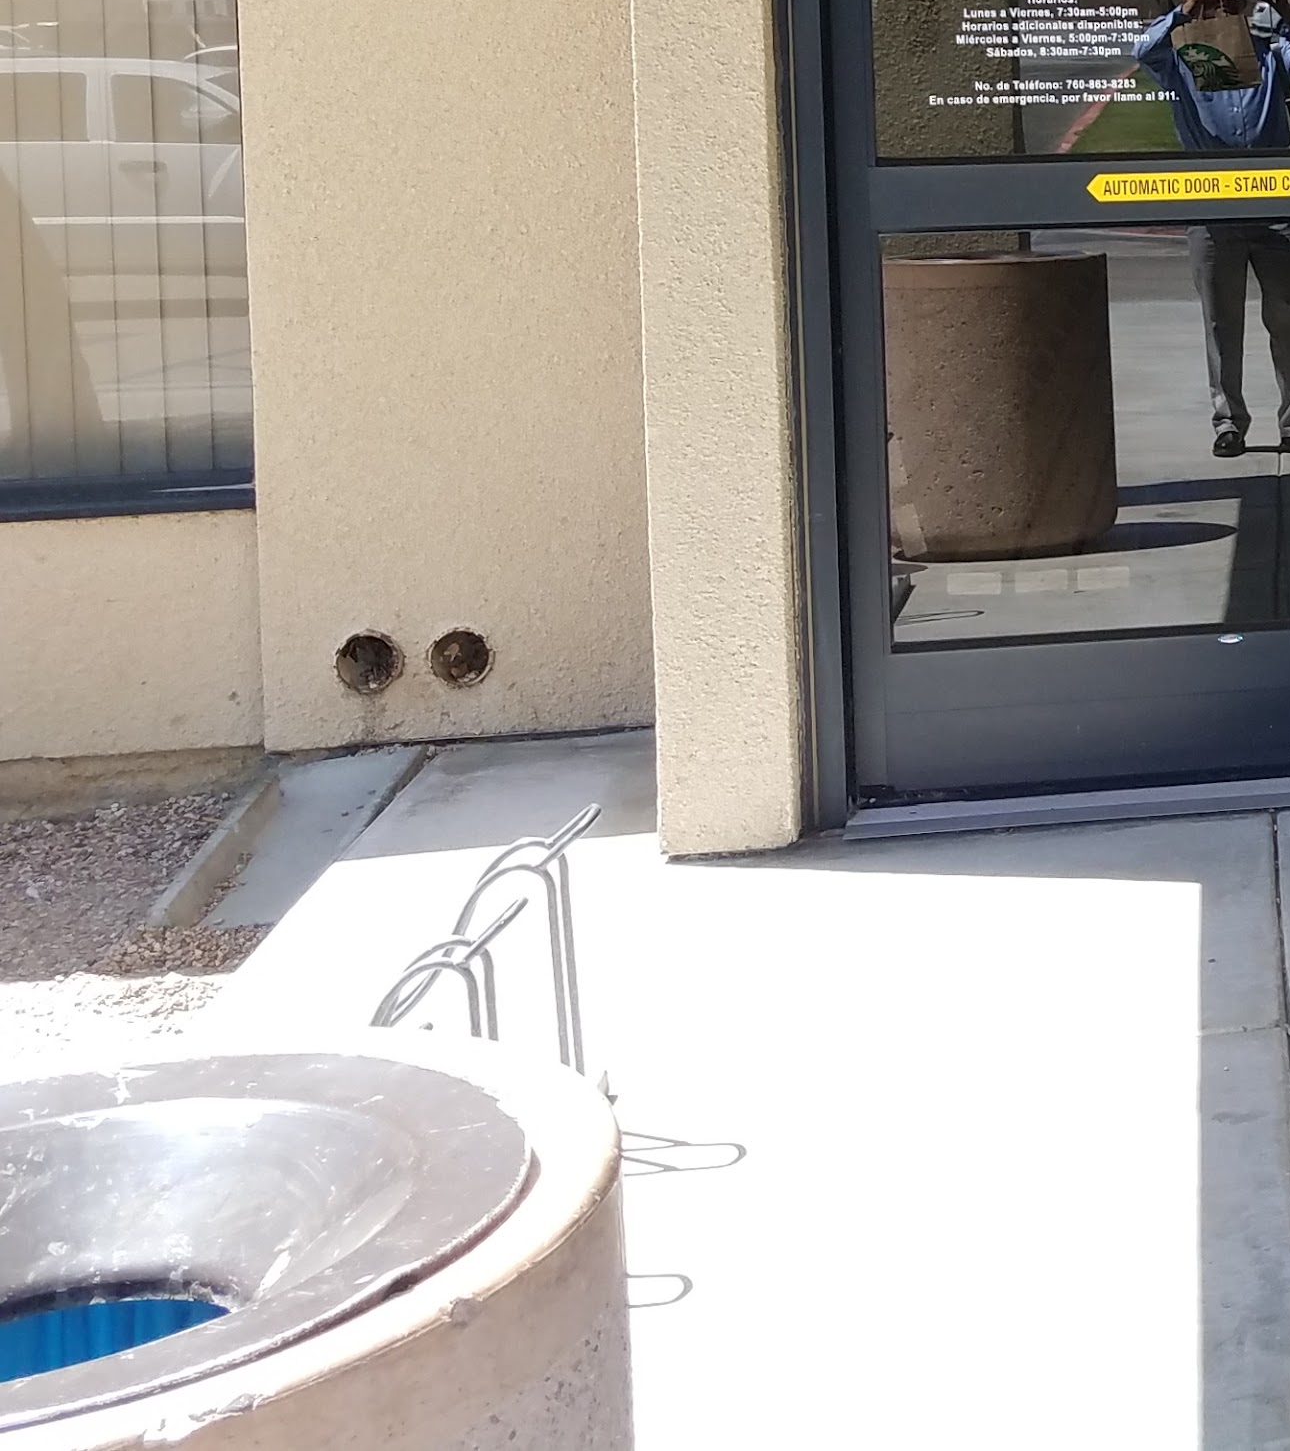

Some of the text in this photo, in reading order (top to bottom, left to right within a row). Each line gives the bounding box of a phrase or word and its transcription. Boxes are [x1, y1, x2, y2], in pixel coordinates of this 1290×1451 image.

[963, 7, 1138, 19] Lunes a Viernes, 7:30am-5:00pm
[962, 19, 1143, 31] Horarios adicionales disponibles:
[955, 33, 1150, 45] Miércoles a Viernes, 5:00pm-7:30pm
[986, 46, 1121, 58] Sábados, 8:30am-7:30pm
[974, 79, 1136, 91] No. de Teléfono: 760-863-8283
[929, 91, 1180, 107] En caso de emergencia, por favor llame al 911.
[1103, 179, 1180, 196] AUTOMATIC
[1185, 178, 1220, 194] DOOR
[1234, 176, 1277, 192] STAND
